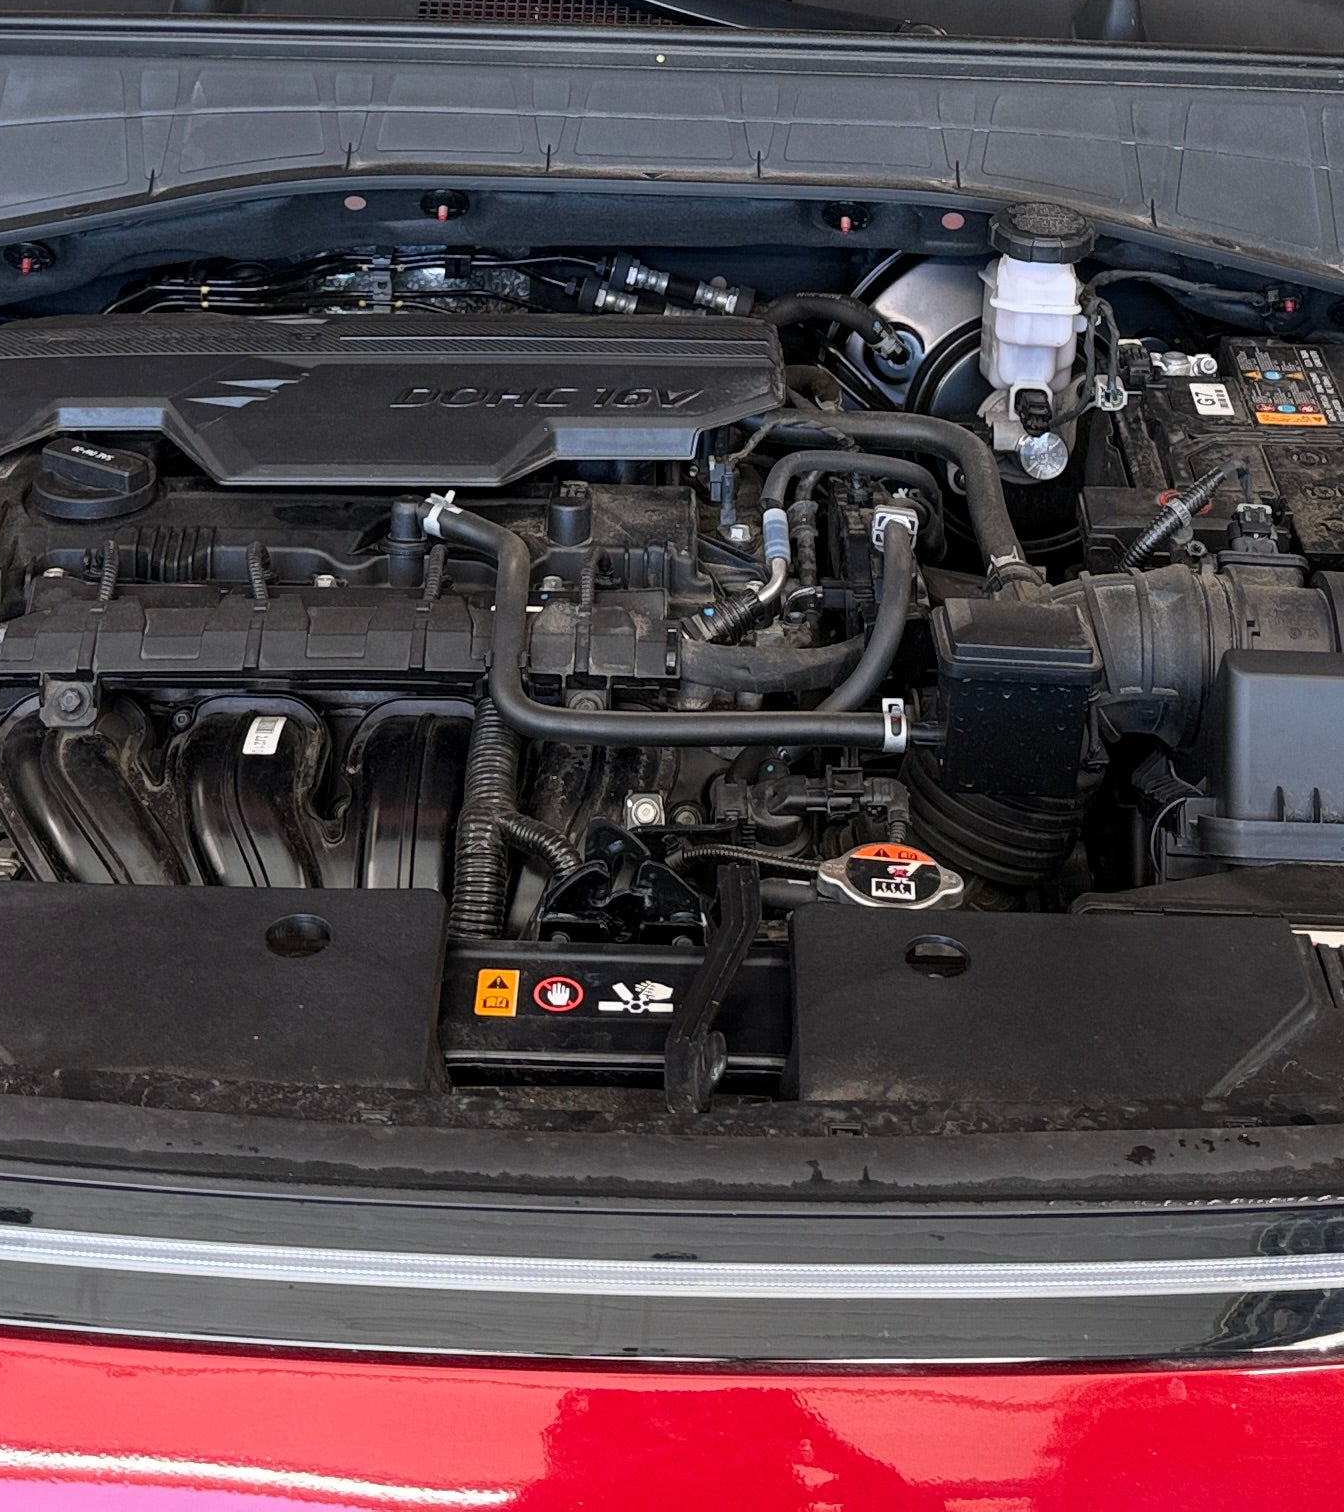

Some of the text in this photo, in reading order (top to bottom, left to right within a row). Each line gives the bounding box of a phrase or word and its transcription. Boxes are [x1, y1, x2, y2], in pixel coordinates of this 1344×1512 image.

[389, 388, 706, 408] DOHC 16V
[1194, 391, 1216, 407] G7
